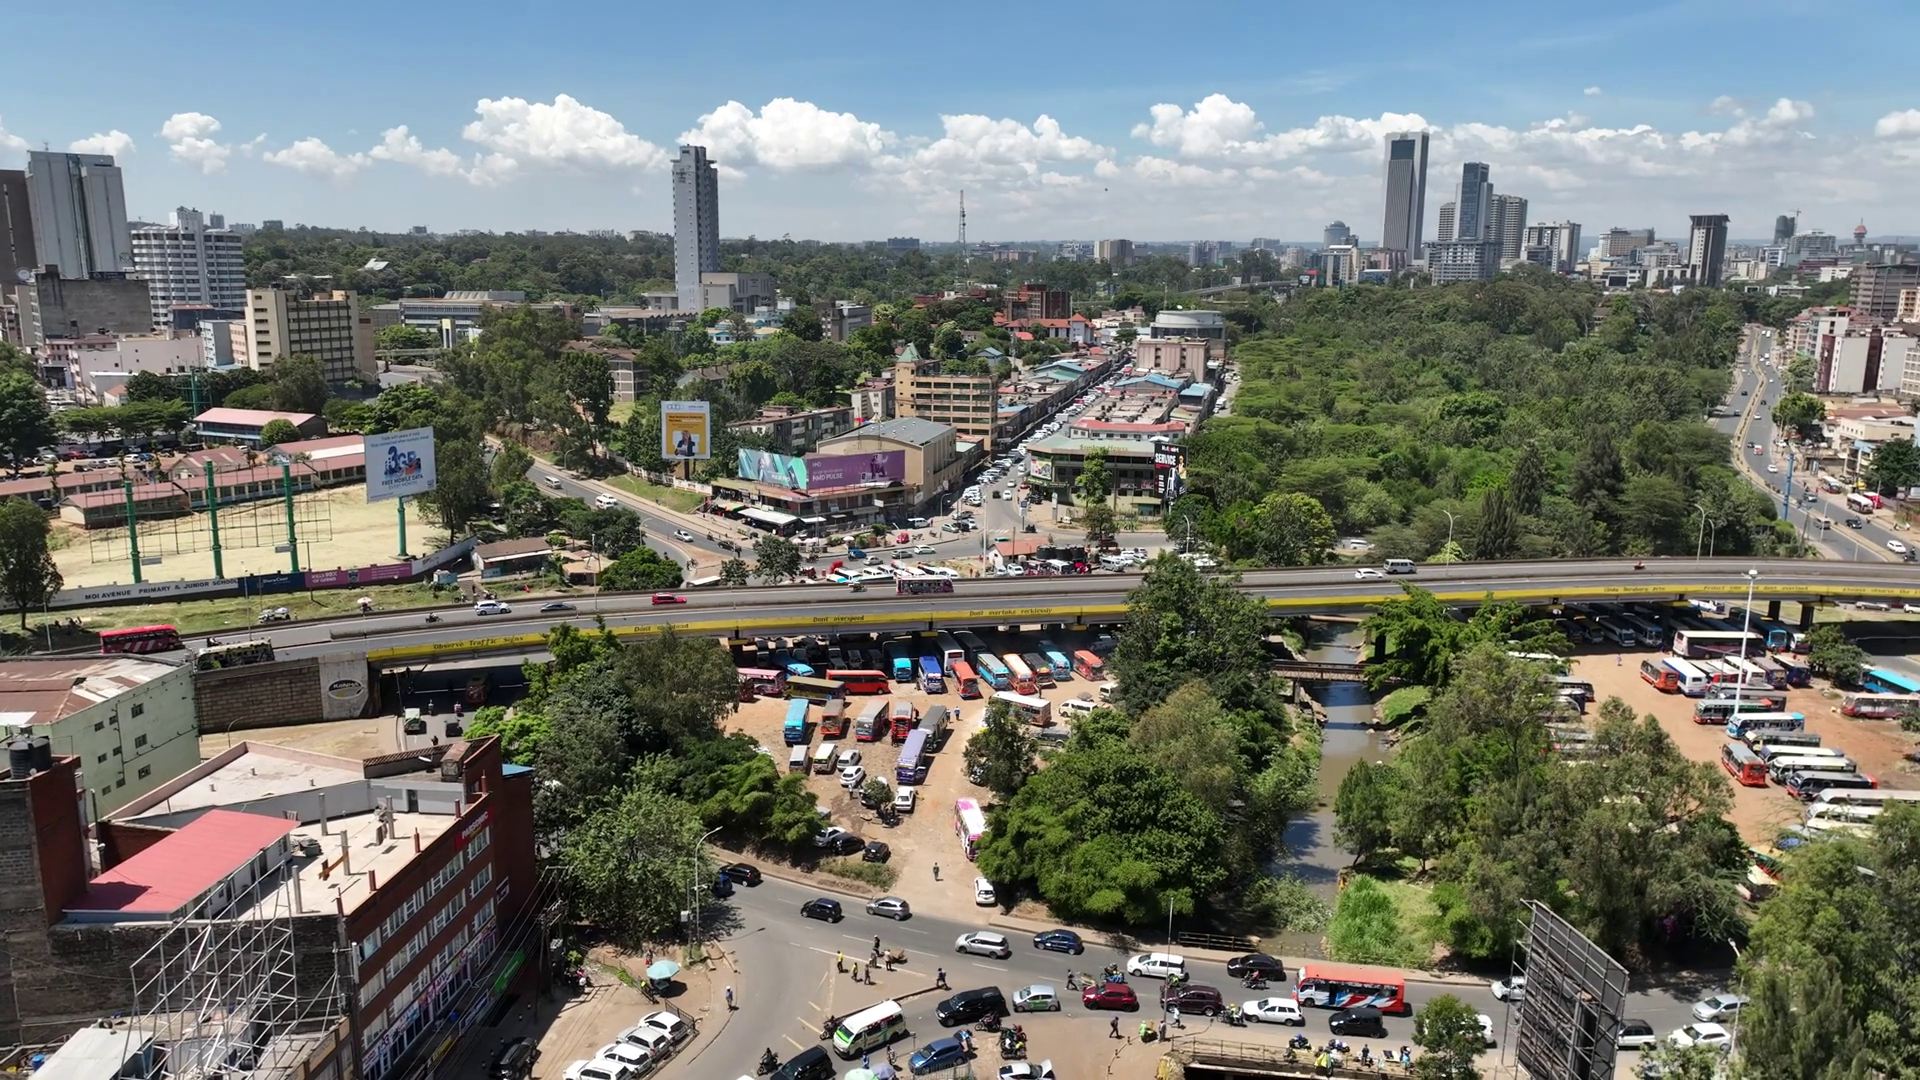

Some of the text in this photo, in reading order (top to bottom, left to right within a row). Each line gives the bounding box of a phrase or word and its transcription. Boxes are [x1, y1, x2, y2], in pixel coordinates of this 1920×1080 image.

[1155, 453, 1176, 466] SERVICE
[394, 476, 411, 484] MOBILE
[826, 472, 844, 481] PULSE
[101, 590, 132, 599] AVENUE
[139, 586, 171, 594] PRIMARY
[183, 581, 210, 589] JUNIOR
[833, 615, 865, 623] overspeed
[433, 636, 524, 650] Observe Traffic Signs
